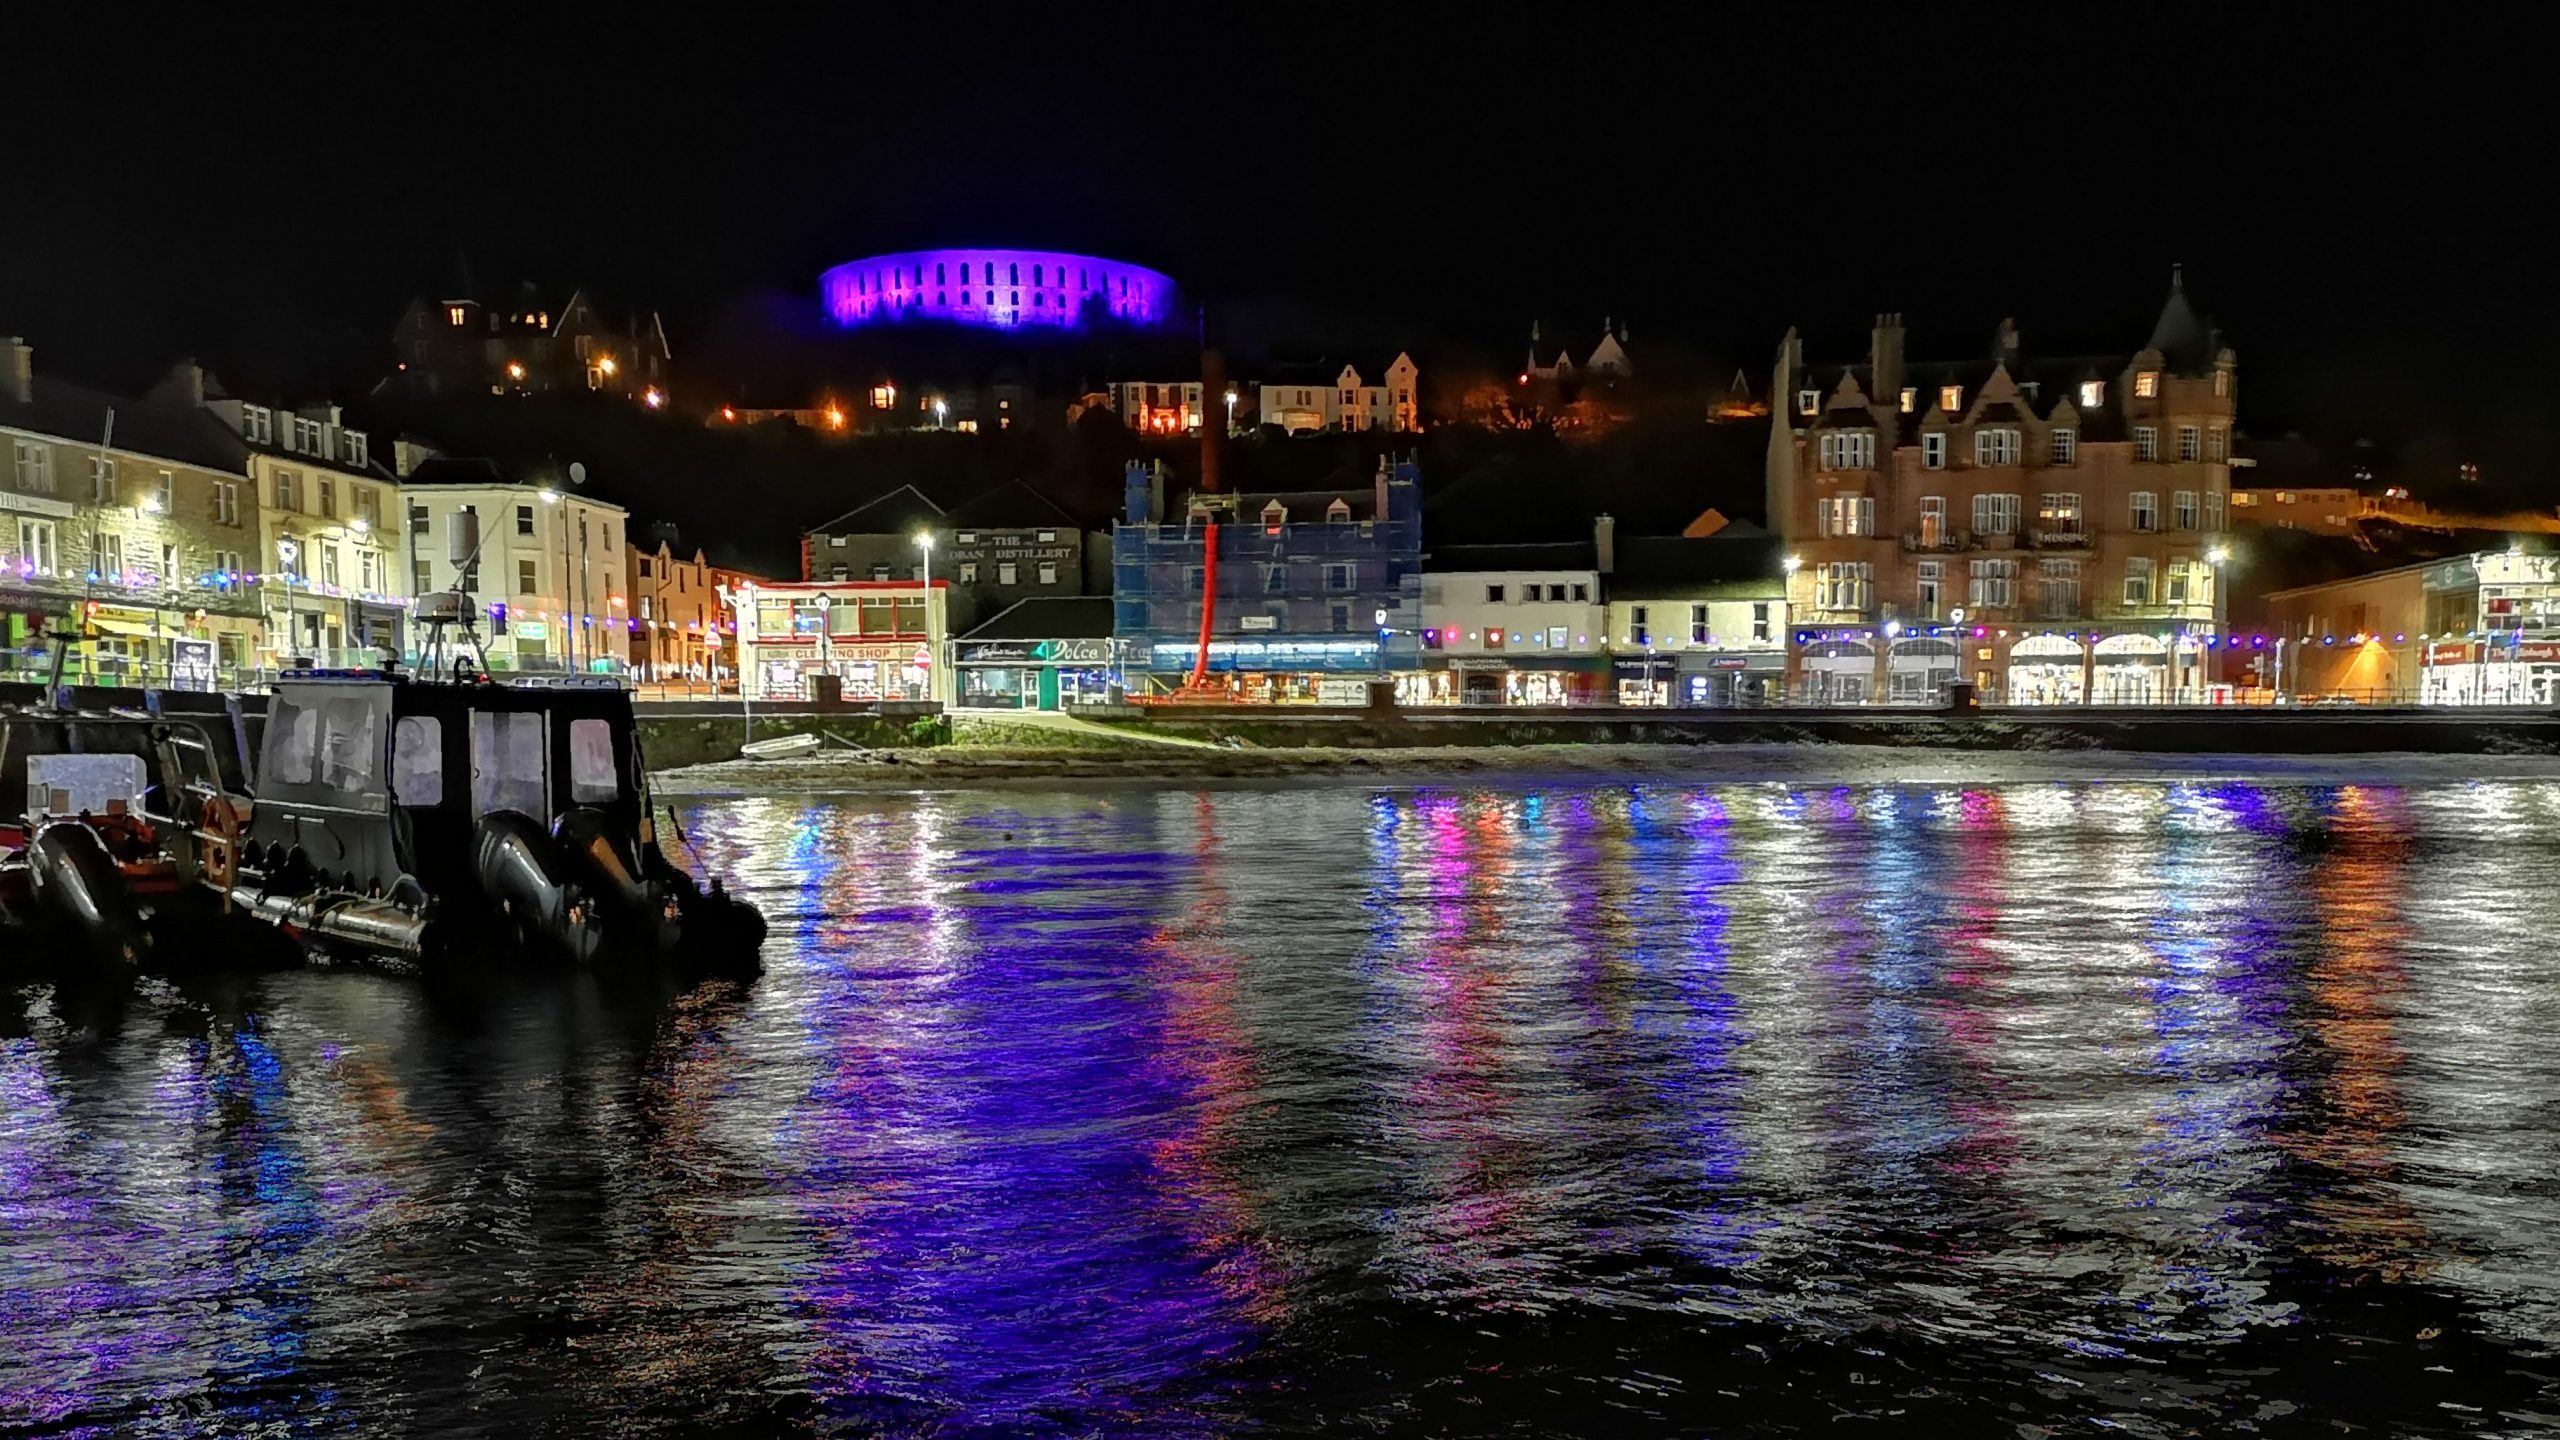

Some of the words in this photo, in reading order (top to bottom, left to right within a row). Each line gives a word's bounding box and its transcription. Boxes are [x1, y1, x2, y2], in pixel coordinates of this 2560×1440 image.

[992, 536, 1021, 546] THE
[948, 549, 985, 560] OBAN
[995, 547, 1072, 559] DISTILLERY
[795, 649, 855, 659] CLEING
[858, 649, 891, 658] SHOP
[1049, 639, 1099, 660] Dolce
